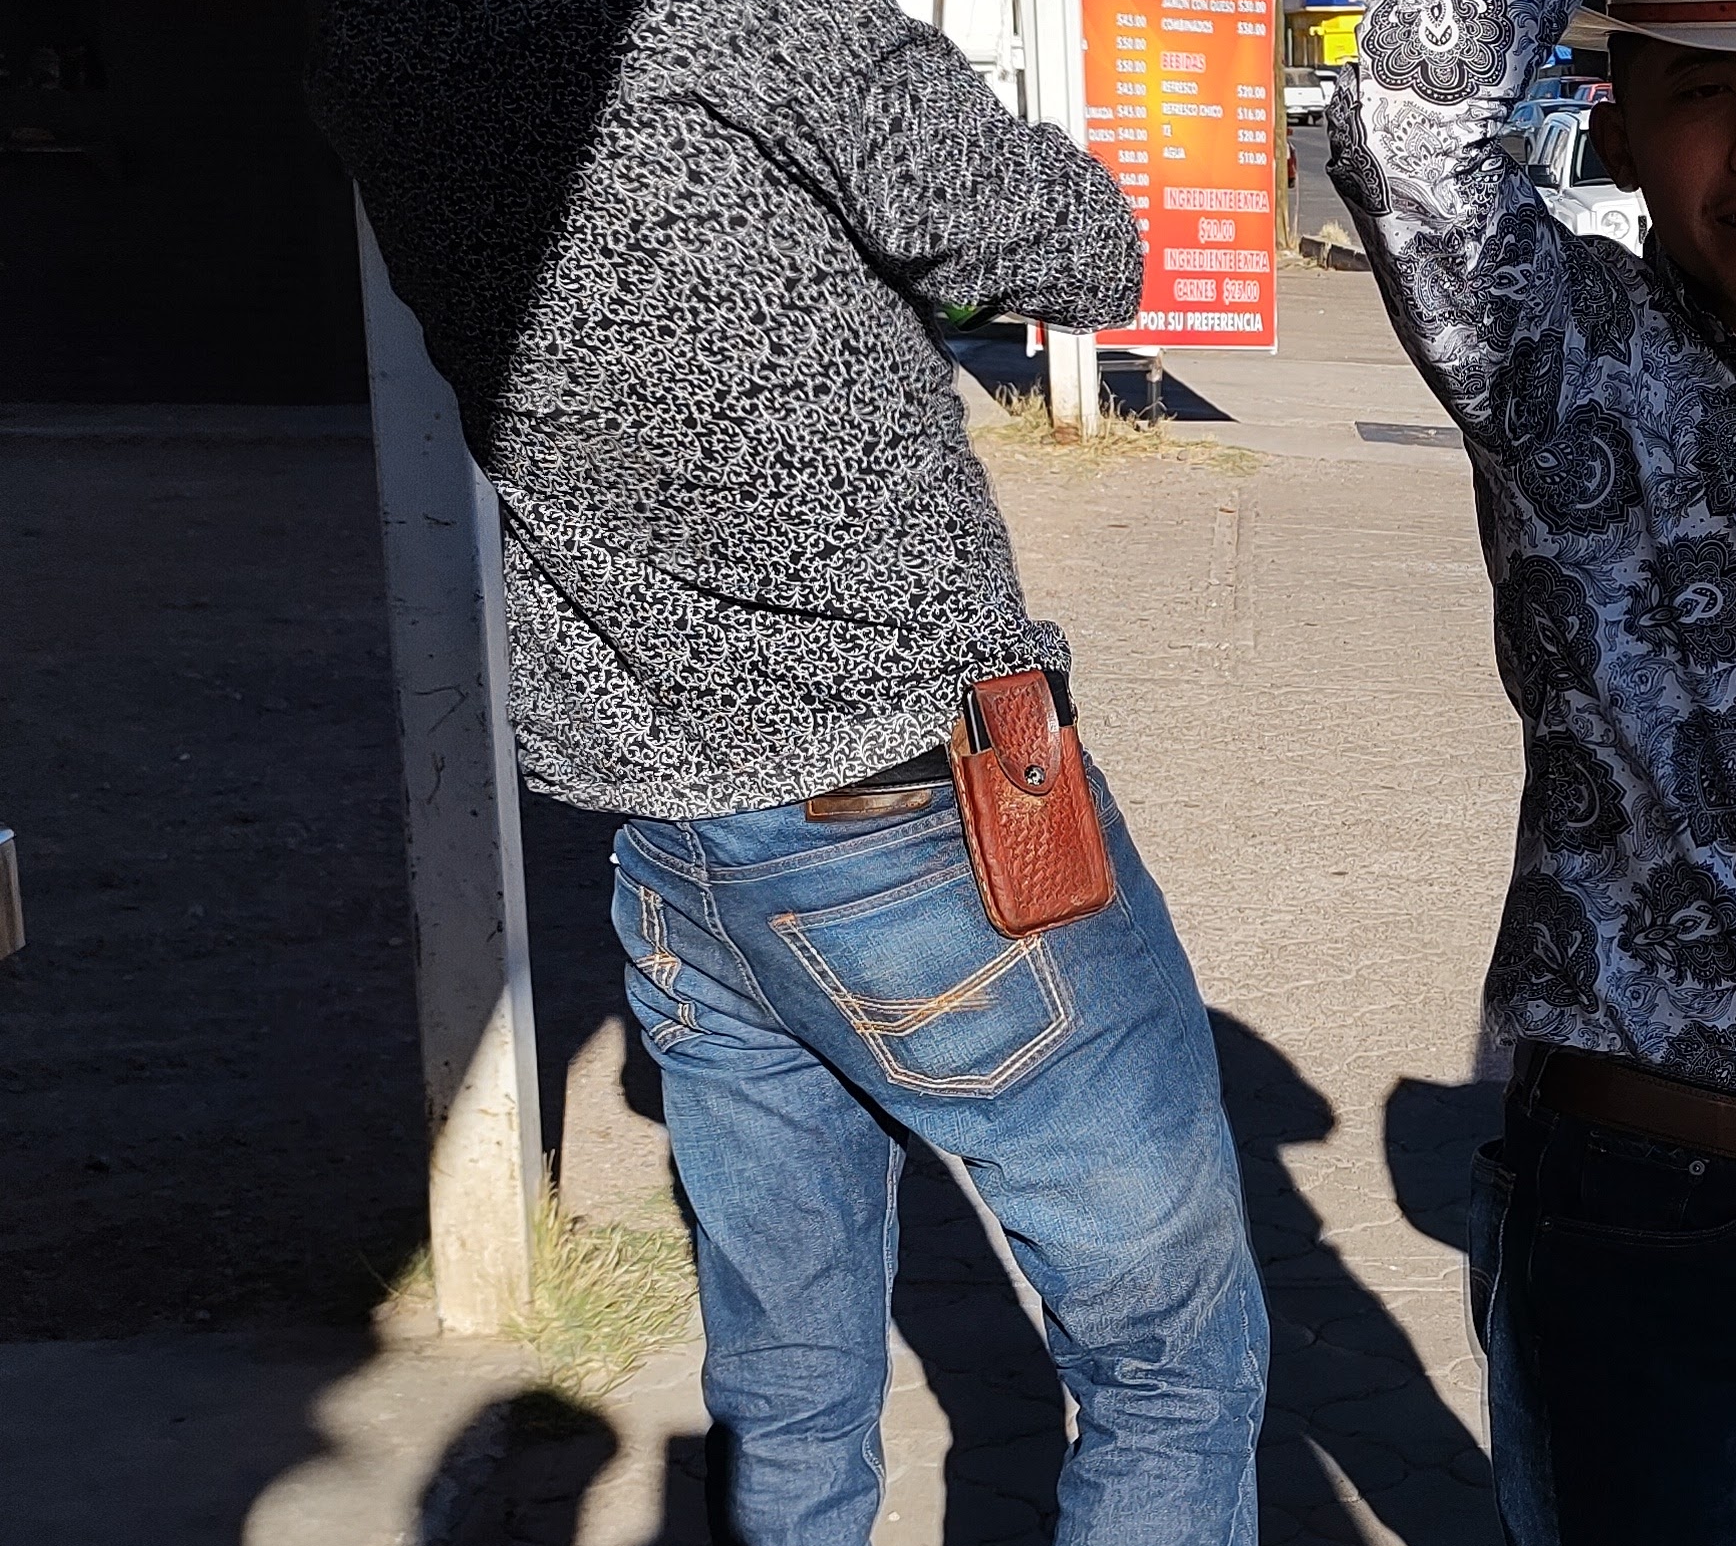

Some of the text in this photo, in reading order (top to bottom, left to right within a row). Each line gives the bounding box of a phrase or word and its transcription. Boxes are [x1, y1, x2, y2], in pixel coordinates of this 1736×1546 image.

[1160, 51, 1206, 73] BEBIDAS
[1161, 80, 1198, 95] REFRESCO
[1161, 102, 1198, 117] REFRESCO
[1163, 146, 1186, 159] AGUA
[1164, 187, 1270, 212] INGREDIENTE EXTRA
[1199, 217, 1235, 244] $20.00
[1164, 248, 1270, 272] INGREDIENTE EXTRA
[1174, 278, 1260, 305] CARNES $25.00
[1140, 312, 1165, 331] POR
[1167, 312, 1183, 331] SU
[1187, 312, 1263, 331] PREFERENCIA
